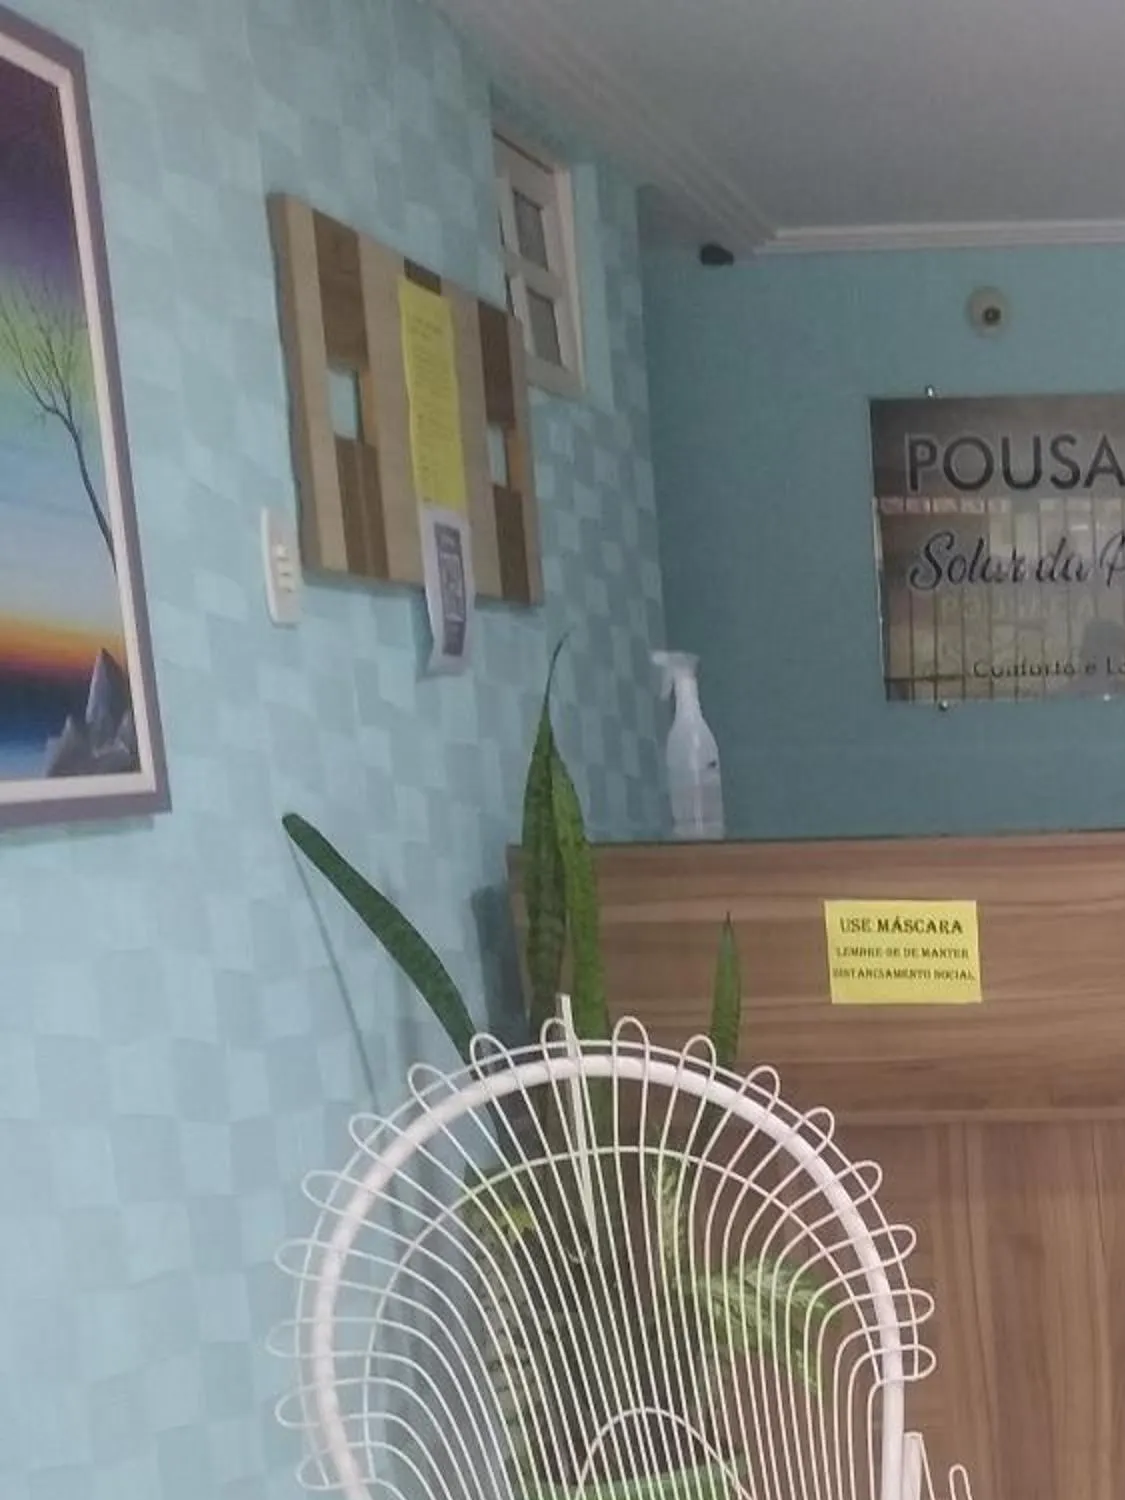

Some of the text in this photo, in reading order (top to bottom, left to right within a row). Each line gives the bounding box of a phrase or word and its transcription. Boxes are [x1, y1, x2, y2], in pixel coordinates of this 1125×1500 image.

[909, 531, 1027, 590] Solar
[1035, 537, 1090, 584] da
[839, 915, 964, 934] USE MÁSCARA
